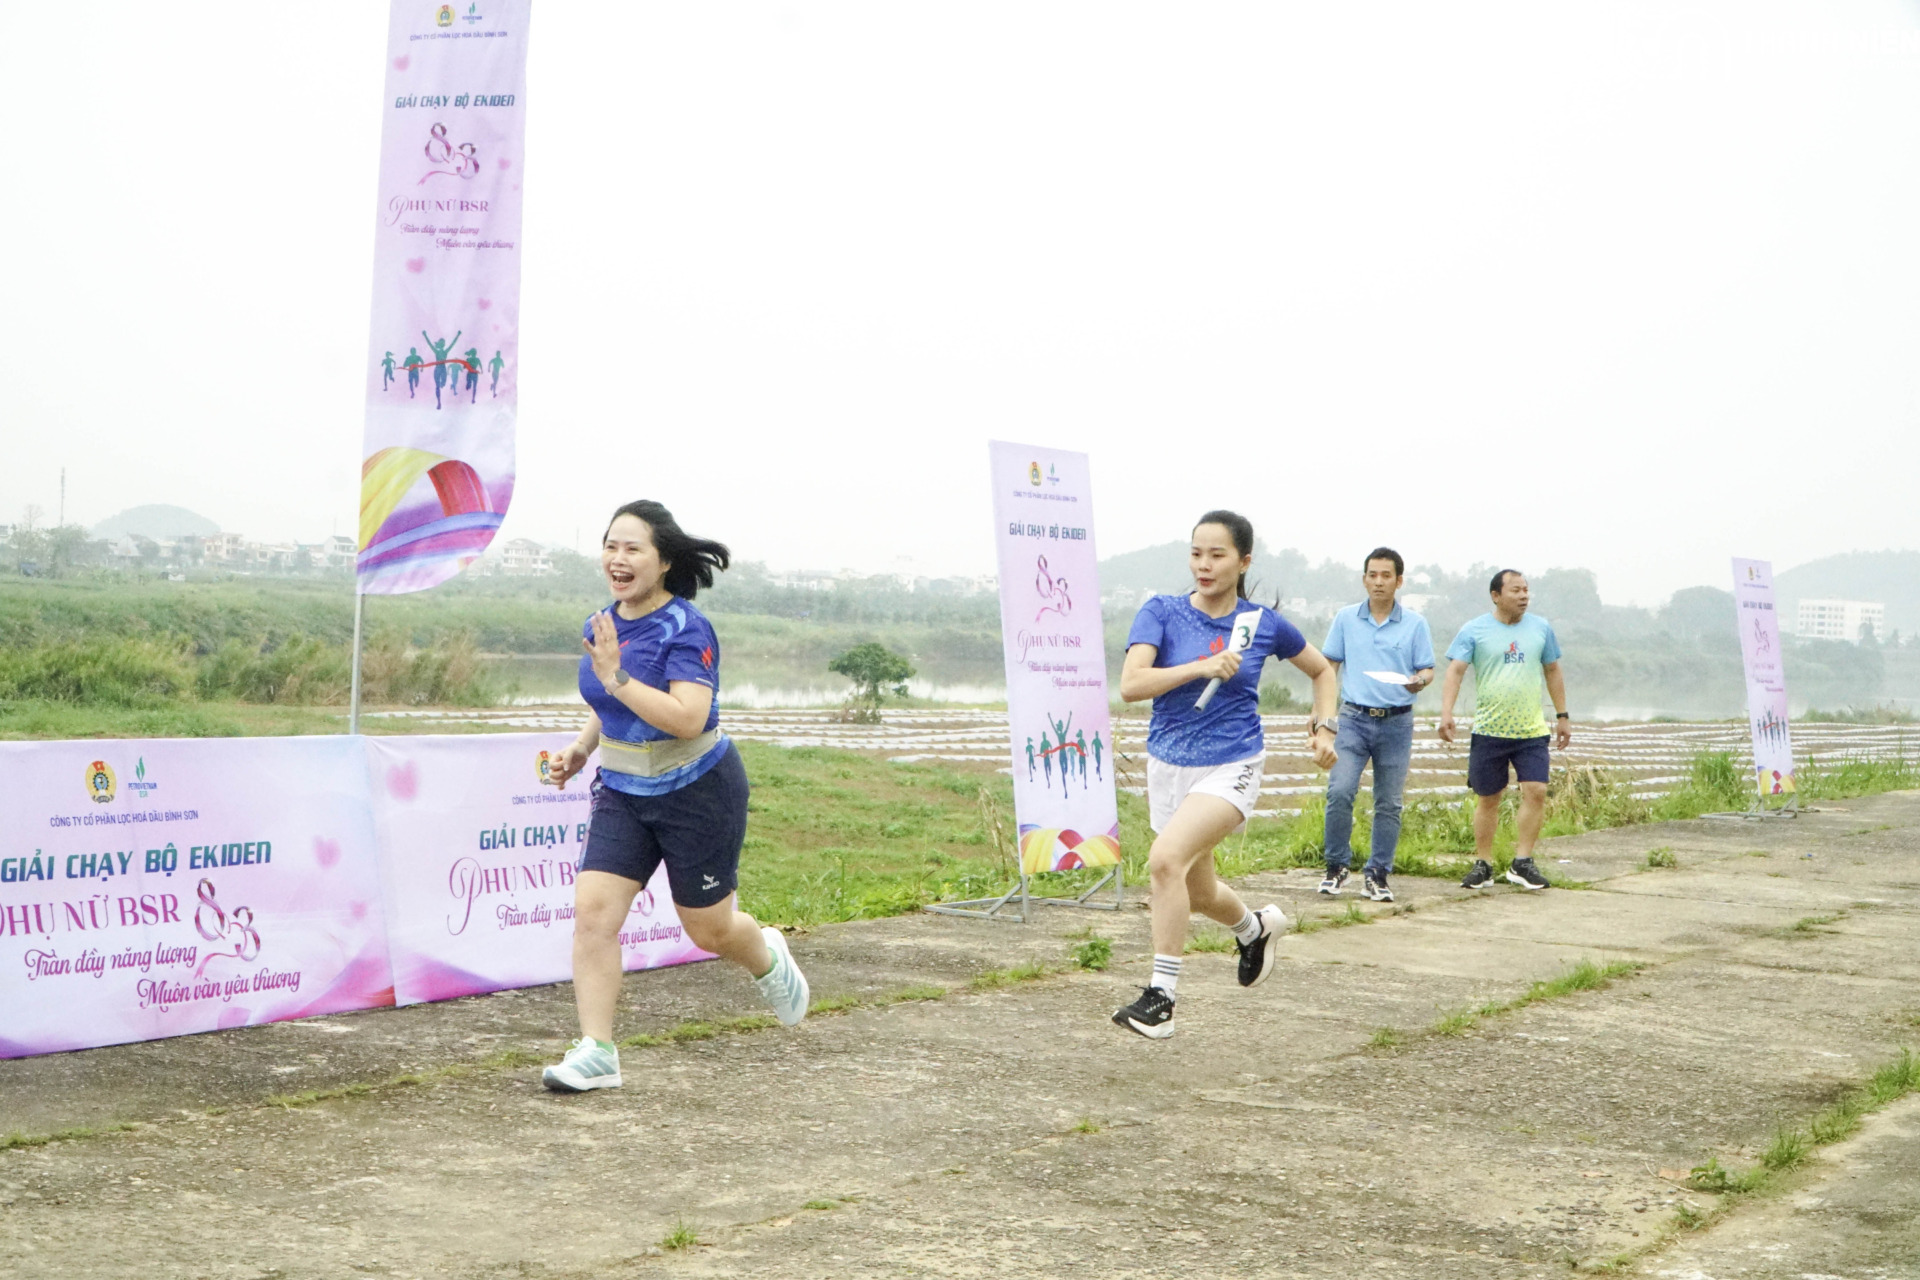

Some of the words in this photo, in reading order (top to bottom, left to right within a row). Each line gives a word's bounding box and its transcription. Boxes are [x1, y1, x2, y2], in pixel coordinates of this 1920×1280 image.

[420, 95, 450, 110] CHẠY
[454, 92, 469, 109] BỘ
[473, 94, 515, 107] EKIDEN
[460, 200, 489, 212] BSR
[1027, 524, 1046, 540] CHẠY
[1049, 524, 1059, 541] BỘ
[1062, 527, 1086, 540] EKIDEN
[1063, 636, 1081, 648] BSR
[1238, 625, 1250, 648] 3
[1504, 652, 1525, 664] BSR
[1233, 764, 1254, 795] RUN
[50, 814, 71, 828] CÔNG
[72, 816, 82, 826] TY
[96, 812, 116, 826] PHẦN
[117, 814, 131, 826] LỌC
[132, 811, 147, 824] HOÁ
[165, 810, 182, 822] BÌNH
[184, 810, 199, 821] SƠN
[479, 822, 516, 850] GIẢI
[523, 824, 569, 850] CHẠY
[1, 848, 54, 883] GIẢI
[66, 850, 133, 882] CHẠY
[145, 842, 178, 877] BỘ
[190, 840, 272, 870] EKIDEN
[447, 857, 518, 936] PHỤ
[524, 858, 554, 890] NỮ
[0, 902, 55, 941] HỤ
[64, 894, 110, 932] NỮ
[118, 893, 182, 928] BSR
[496, 902, 528, 930] Tràn
[530, 901, 552, 928] đầy
[554, 902, 576, 920] năn
[630, 926, 648, 950] yêu
[650, 922, 682, 944] thương
[25, 948, 72, 981] Tràn
[75, 946, 105, 979] đầy
[111, 946, 151, 973] năng
[155, 942, 197, 969] lượng
[136, 978, 190, 1013] Muôn
[194, 976, 221, 1000] vàn
[224, 974, 251, 1003] yêu
[253, 968, 301, 992] thương
